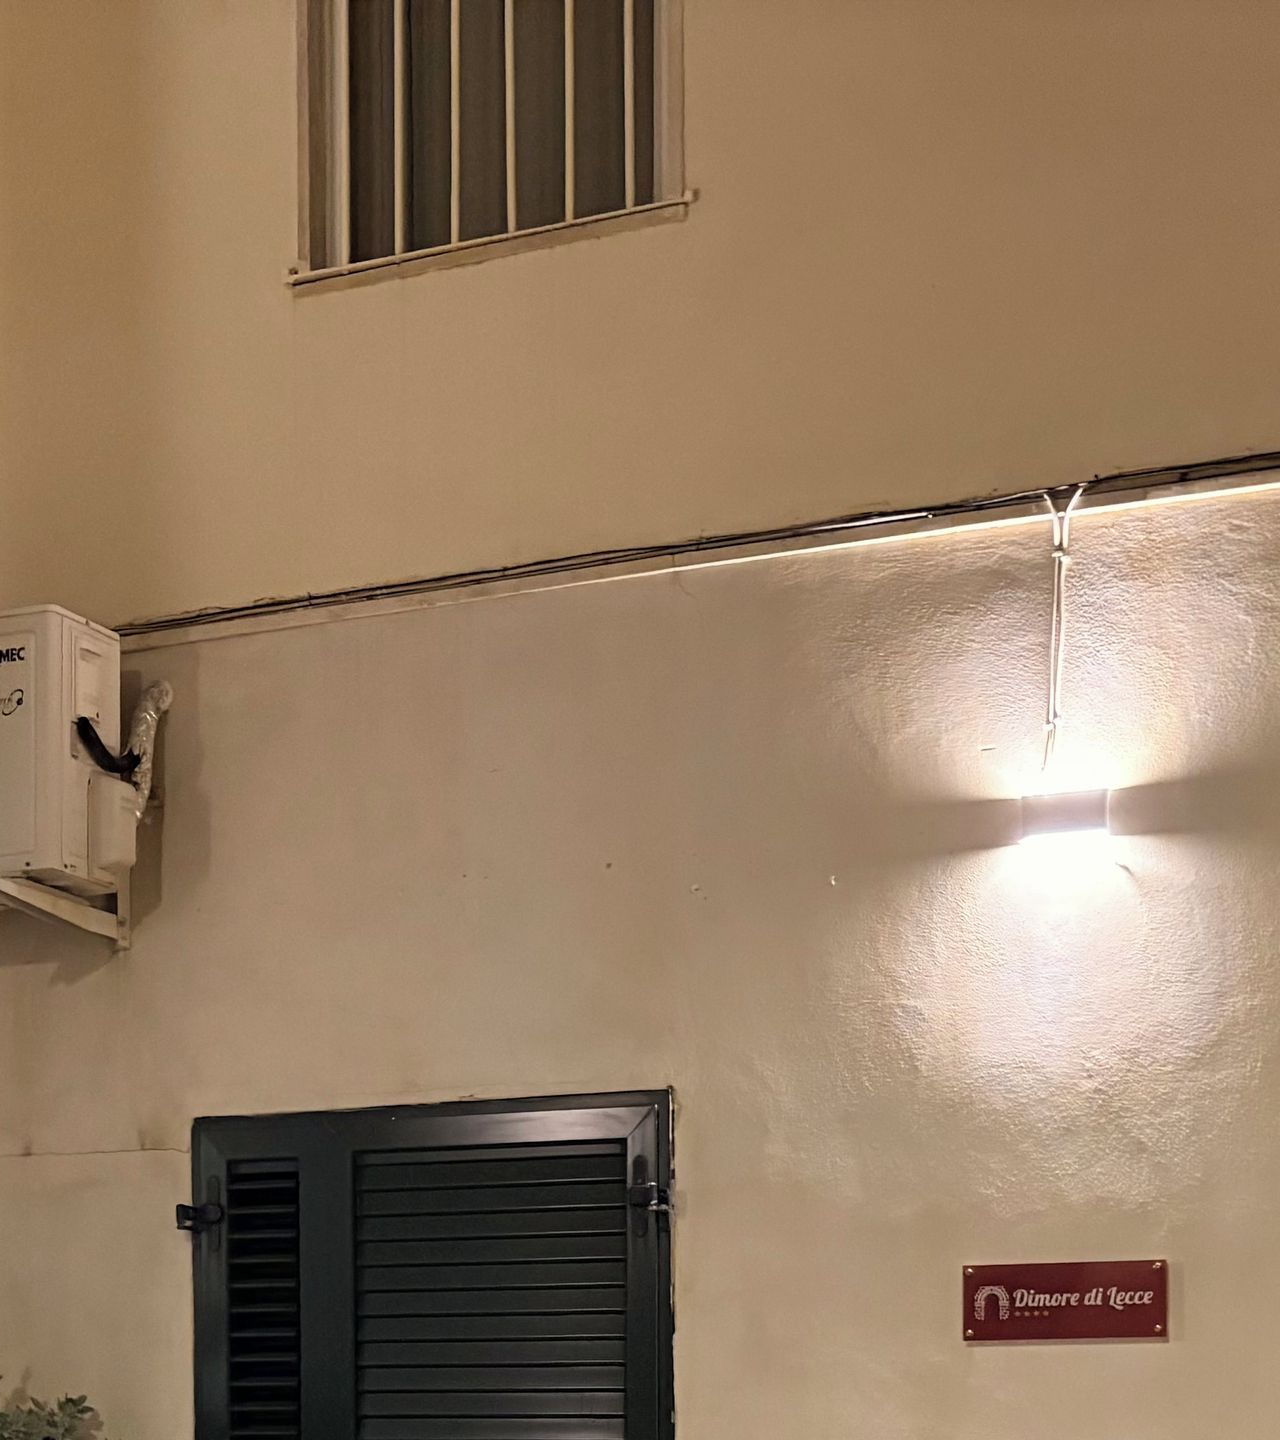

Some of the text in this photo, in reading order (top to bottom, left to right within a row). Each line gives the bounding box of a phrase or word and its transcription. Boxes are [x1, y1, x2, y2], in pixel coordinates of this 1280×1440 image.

[1012, 1286, 1154, 1311] Dimore di Lecce
